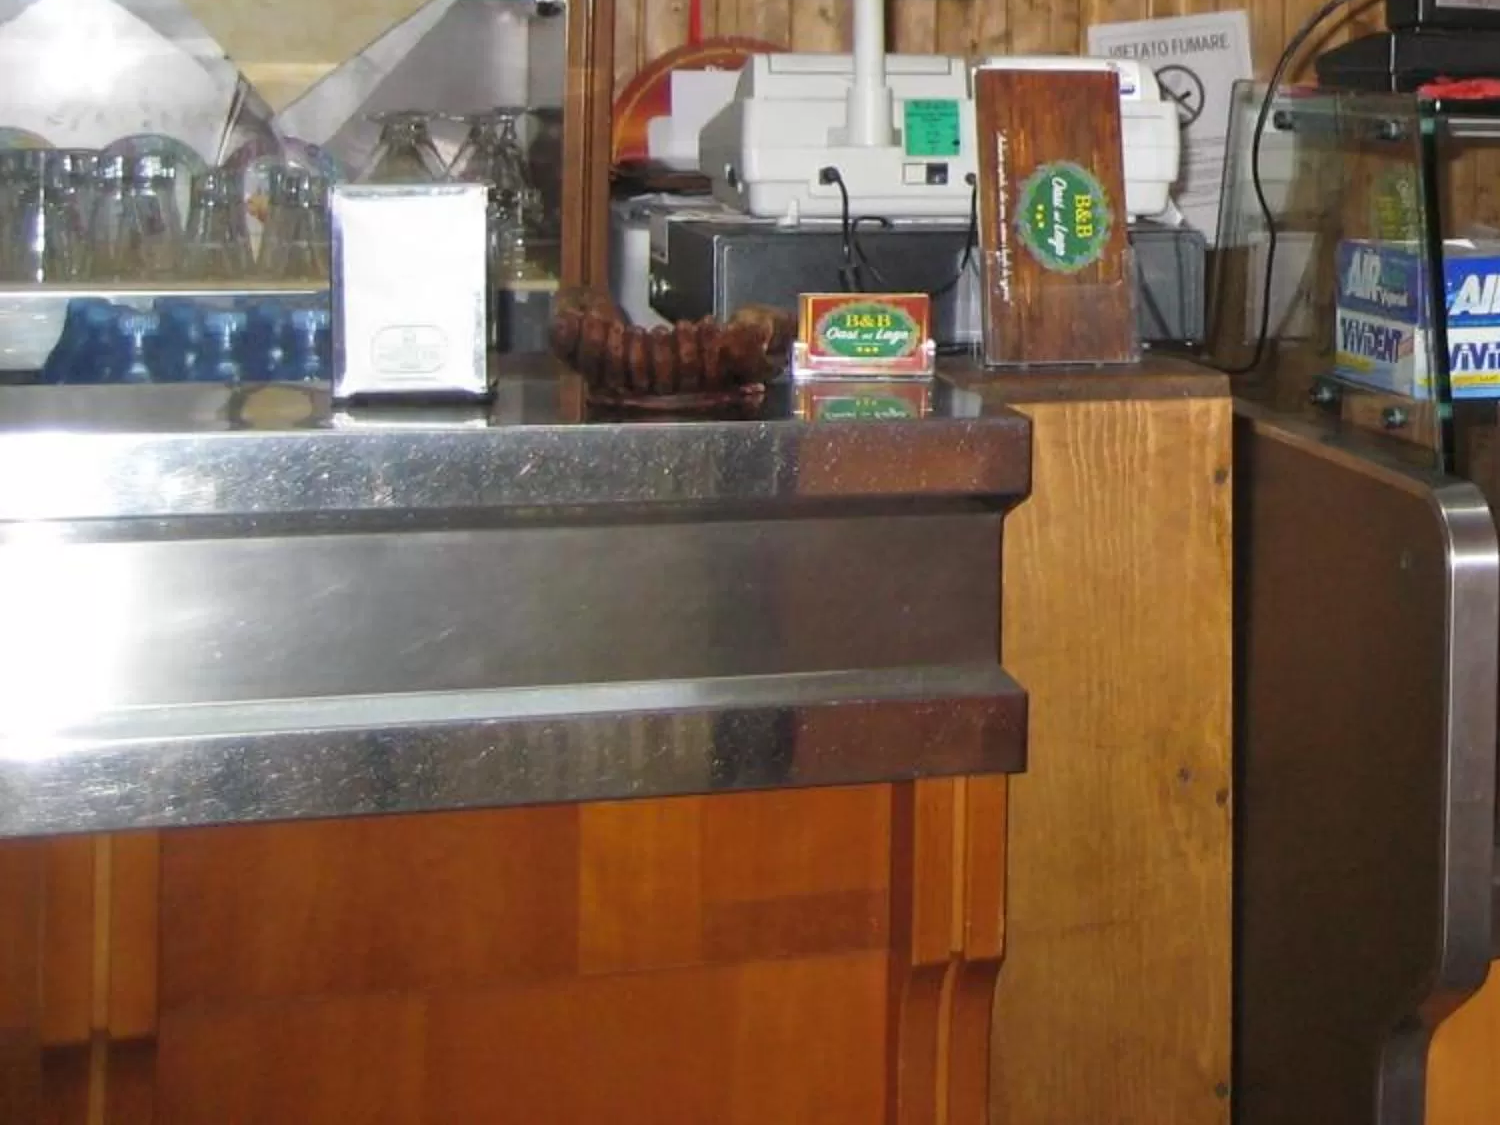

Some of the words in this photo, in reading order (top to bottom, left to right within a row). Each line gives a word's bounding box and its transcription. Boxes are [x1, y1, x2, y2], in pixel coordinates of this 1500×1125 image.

[1172, 33, 1230, 55] FUMARE
[846, 314, 892, 328] B&B
[875, 328, 909, 345] Lago
